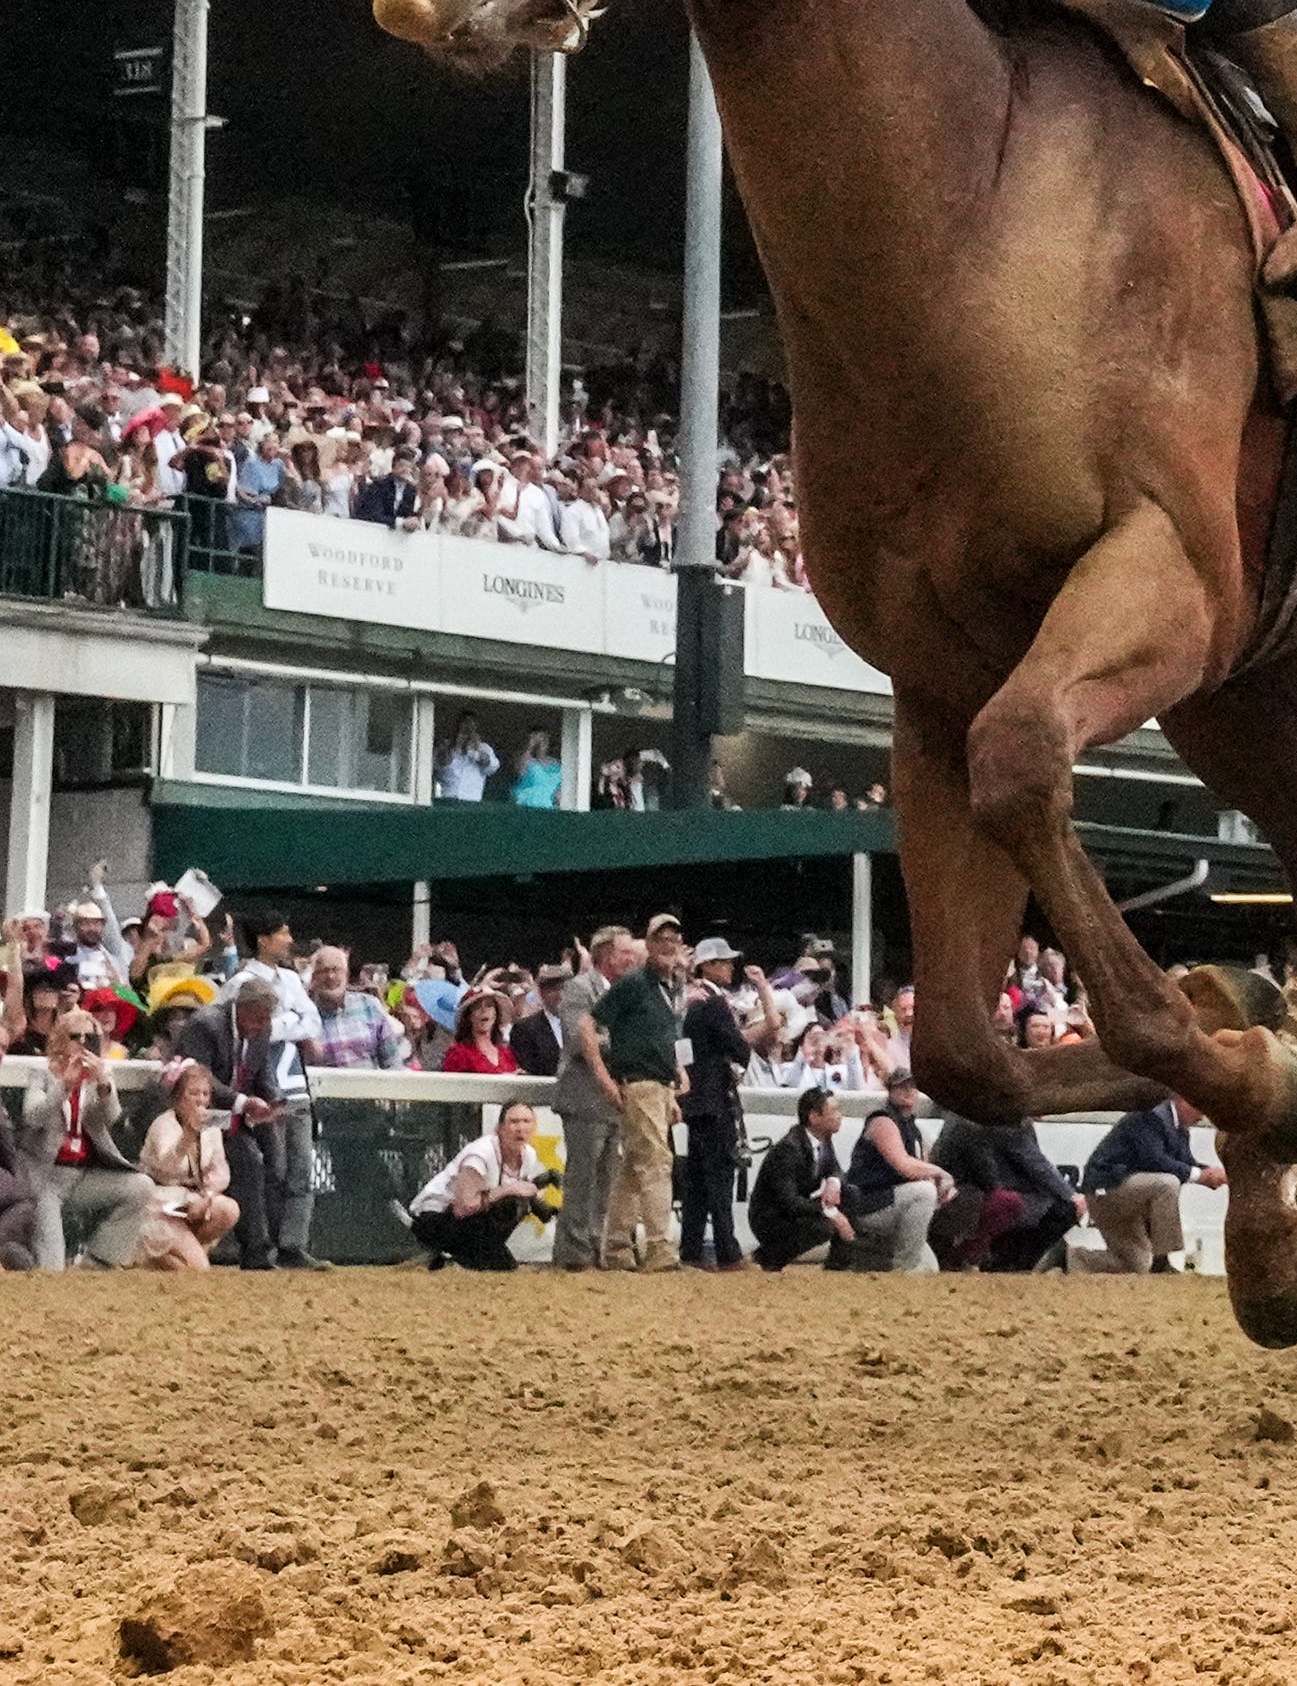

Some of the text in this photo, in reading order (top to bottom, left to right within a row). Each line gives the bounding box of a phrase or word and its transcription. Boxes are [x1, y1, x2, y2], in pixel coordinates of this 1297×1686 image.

[307, 542, 404, 572] WOODFORD
[317, 569, 395, 595] RESERVE
[482, 573, 566, 604] LONGINES
